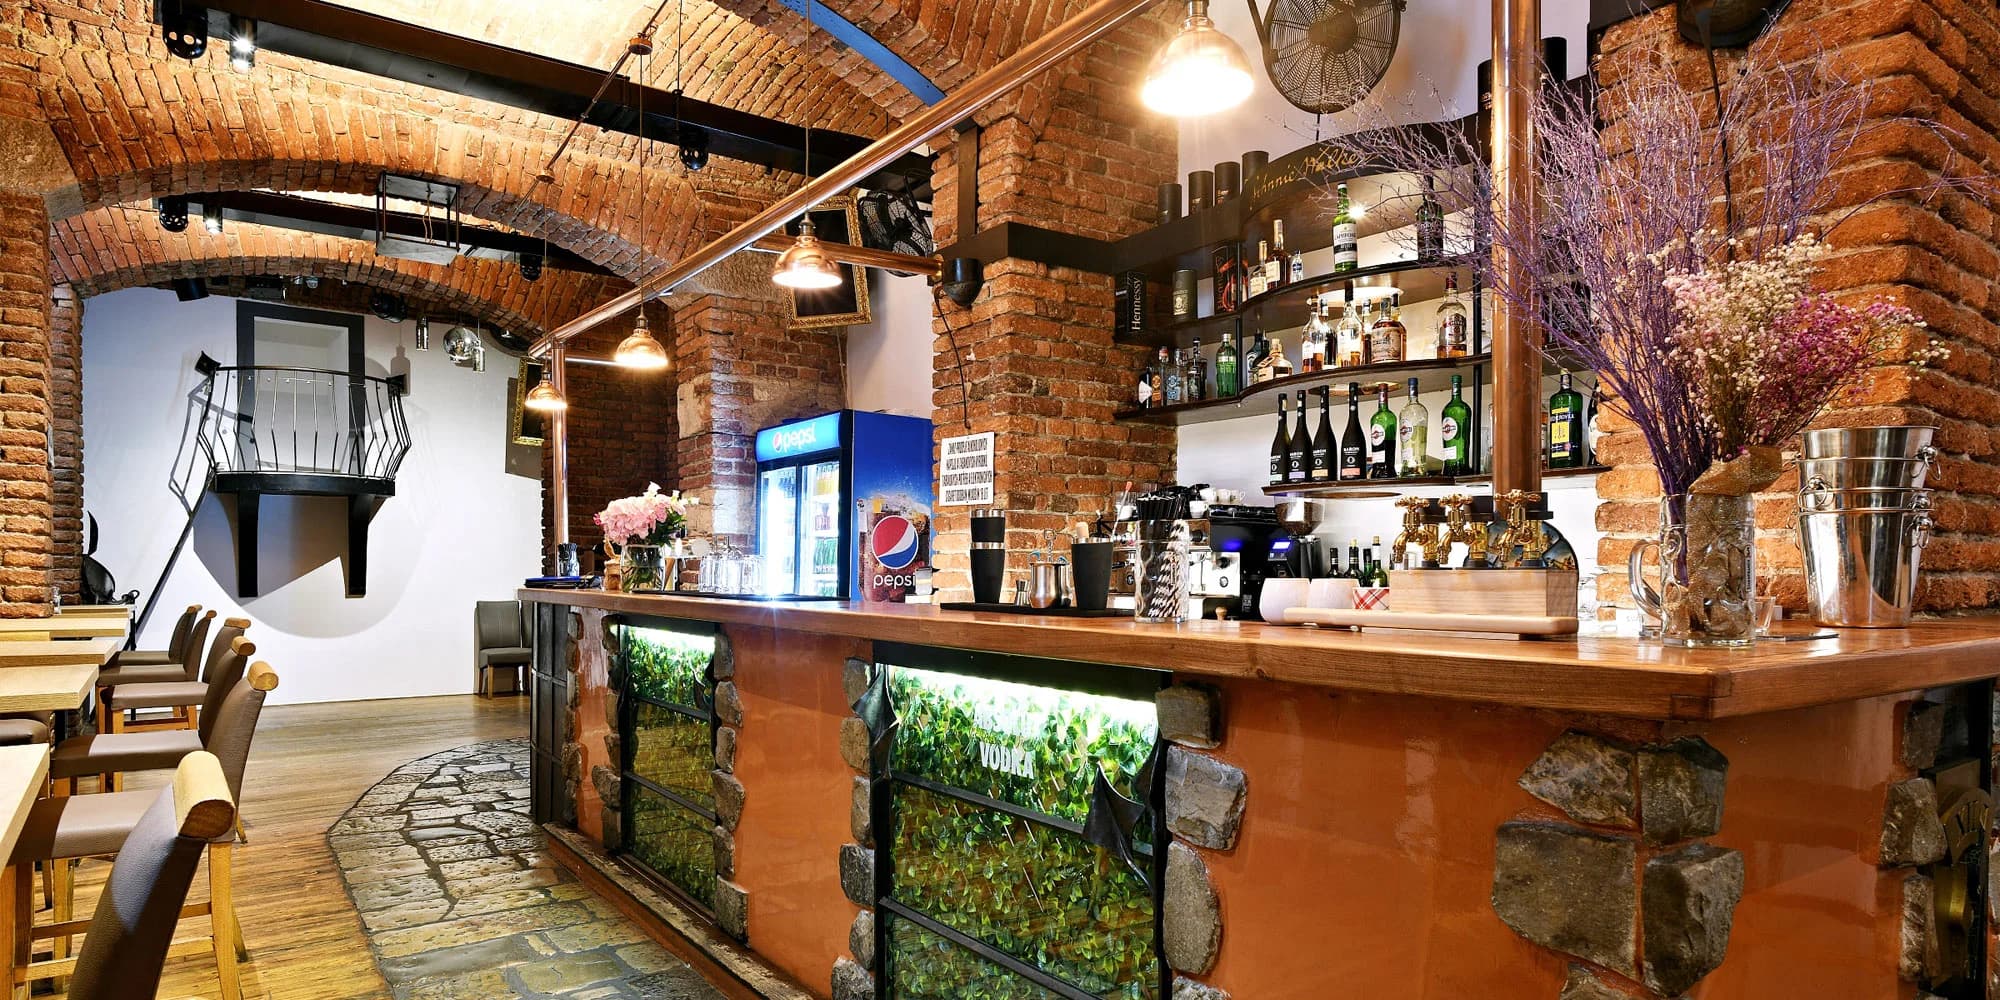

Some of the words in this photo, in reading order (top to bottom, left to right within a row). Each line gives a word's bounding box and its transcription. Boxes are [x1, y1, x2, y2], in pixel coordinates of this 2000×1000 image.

[1131, 276, 1143, 330] Hennessy
[783, 422, 816, 452] pepsi
[873, 572, 916, 589] pepsi
[979, 740, 1034, 779] VODKA
